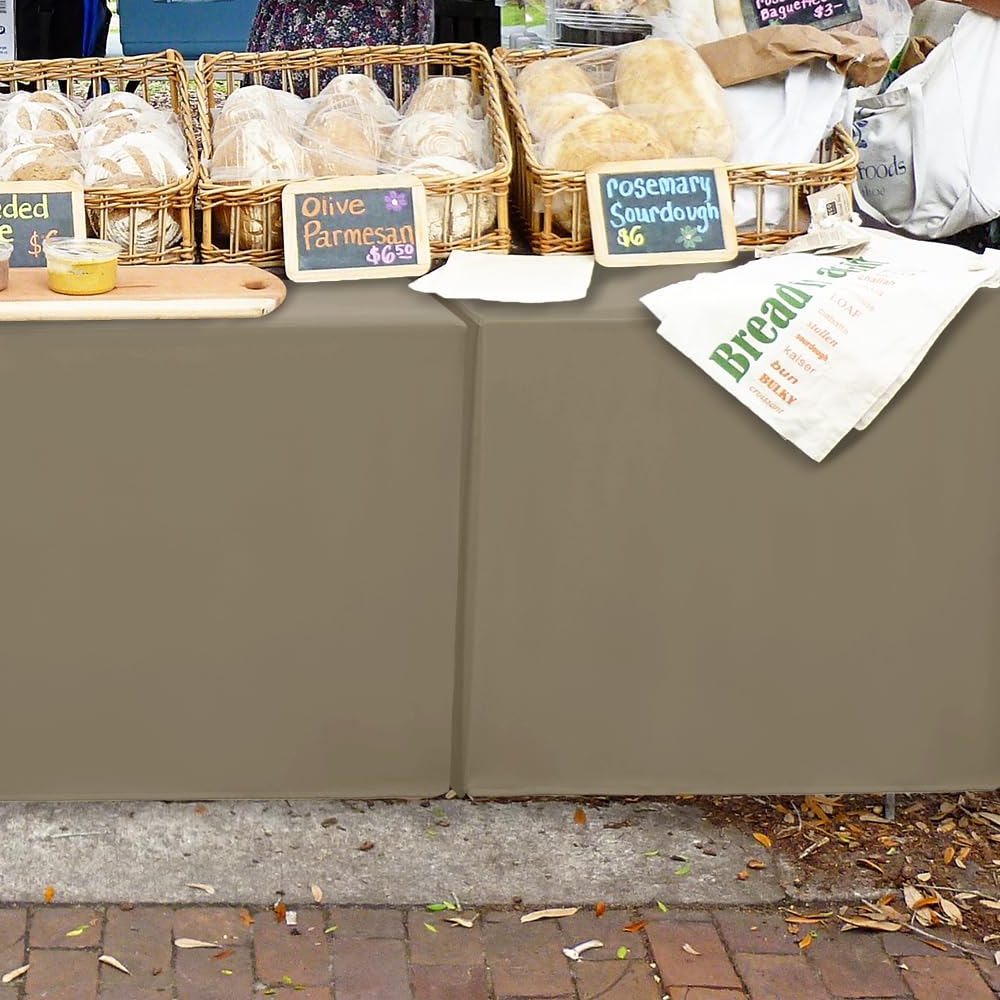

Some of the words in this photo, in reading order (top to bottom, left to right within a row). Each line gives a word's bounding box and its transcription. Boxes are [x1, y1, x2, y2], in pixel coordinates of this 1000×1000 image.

[856, 155, 907, 180] foods
[606, 174, 712, 202] rosemary
[301, 196, 366, 218] Olive
[610, 200, 720, 234] Sourdough
[303, 221, 416, 252] Parmesan
[617, 224, 646, 248] $6
[806, 319, 839, 349] stollen
[769, 360, 800, 386] bun
[783, 345, 817, 376] kaiser
[758, 373, 798, 407] BULKY
